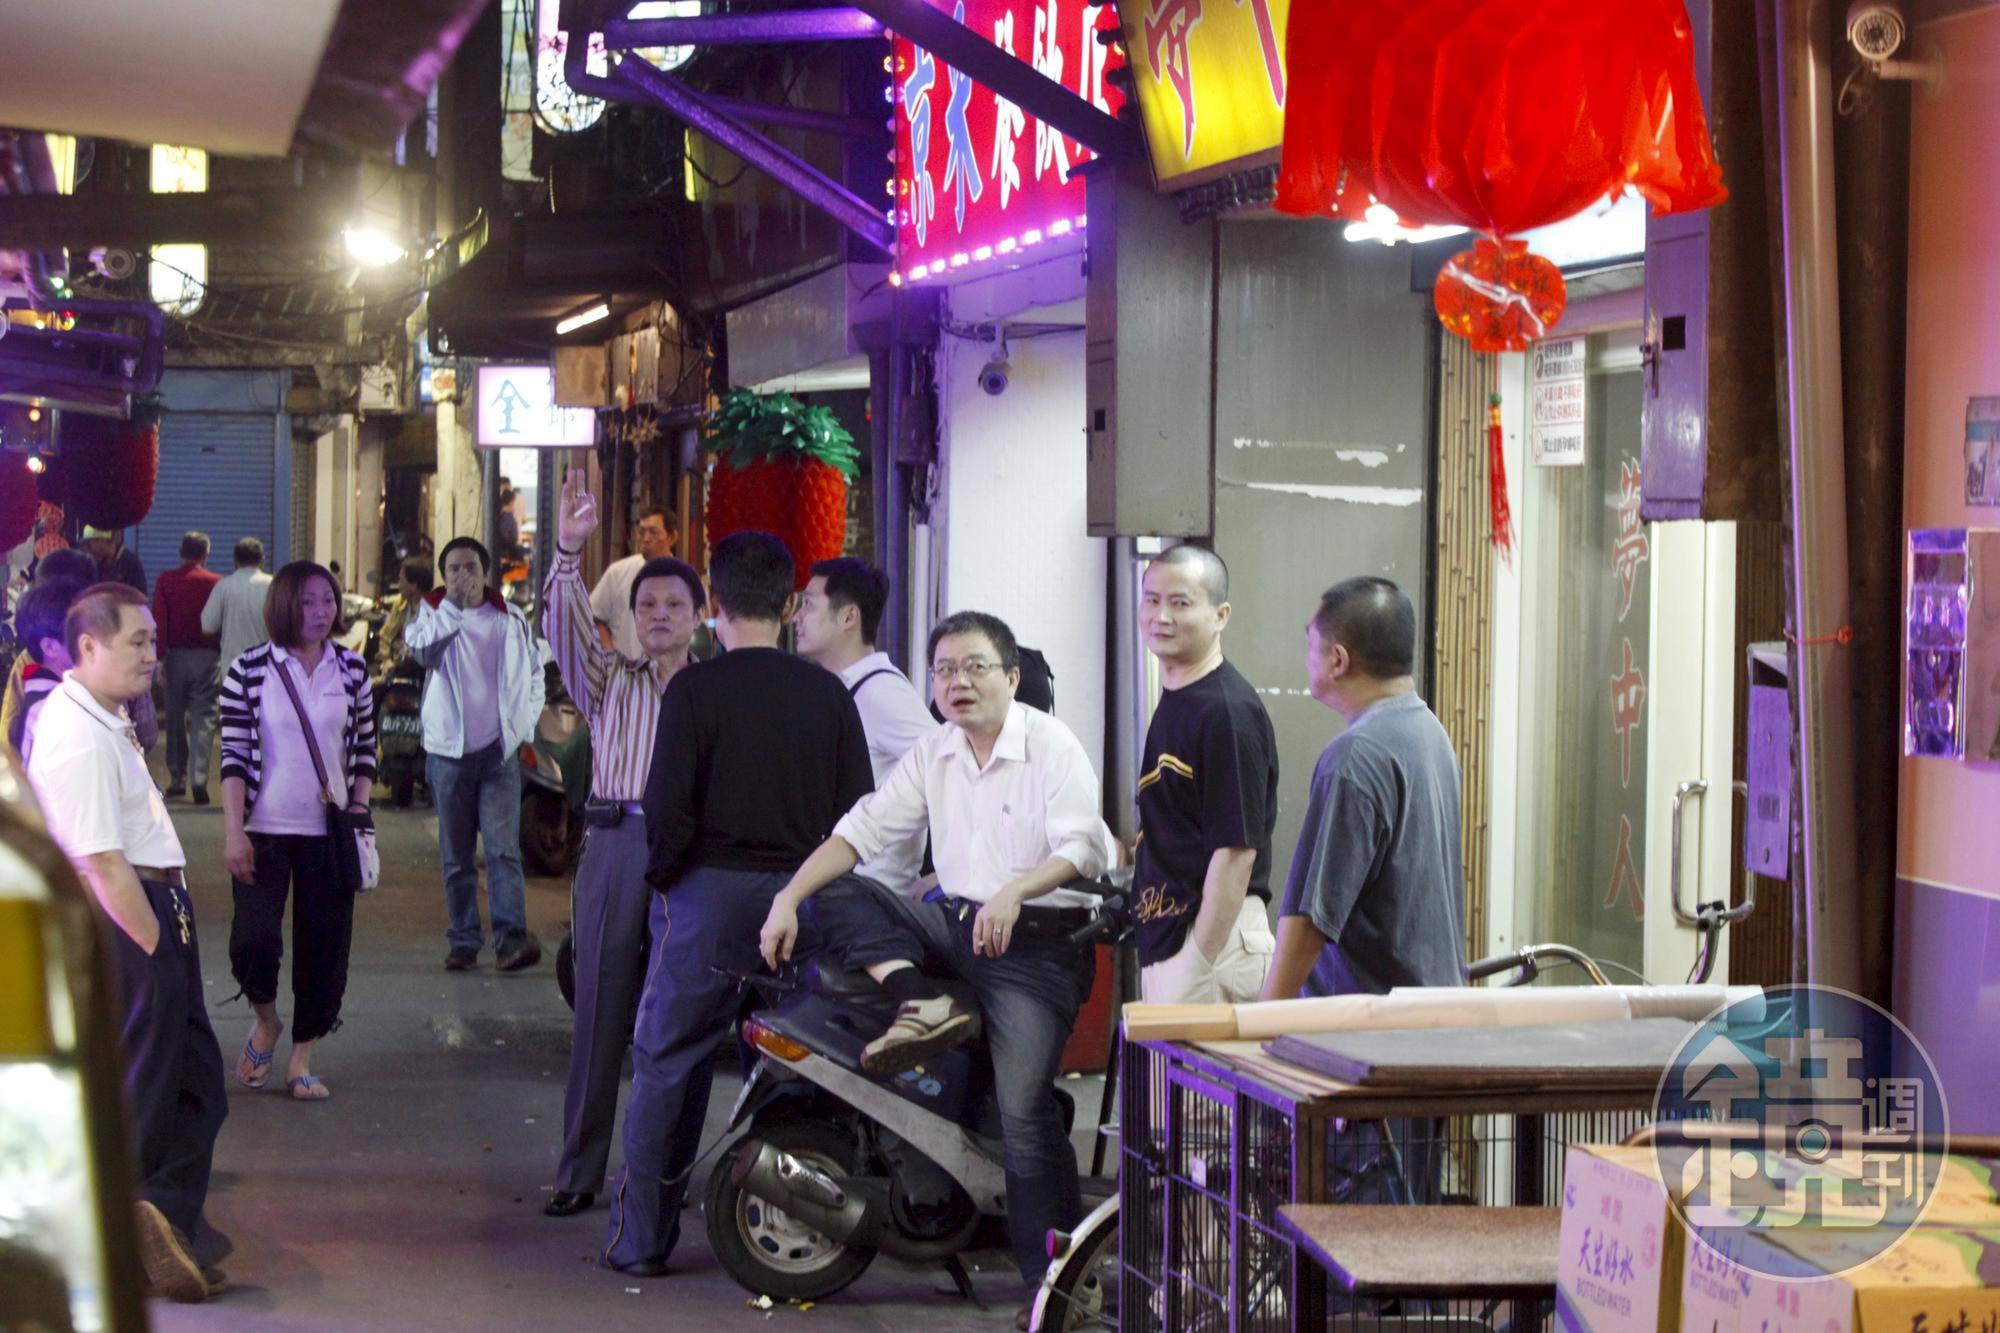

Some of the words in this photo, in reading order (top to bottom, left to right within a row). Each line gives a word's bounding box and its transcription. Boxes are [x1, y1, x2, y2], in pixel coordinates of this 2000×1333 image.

[1603, 456, 1649, 922] 夢中人
[1578, 1226, 1635, 1286] 天生好水
[1607, 1291, 1632, 1318] WATER
